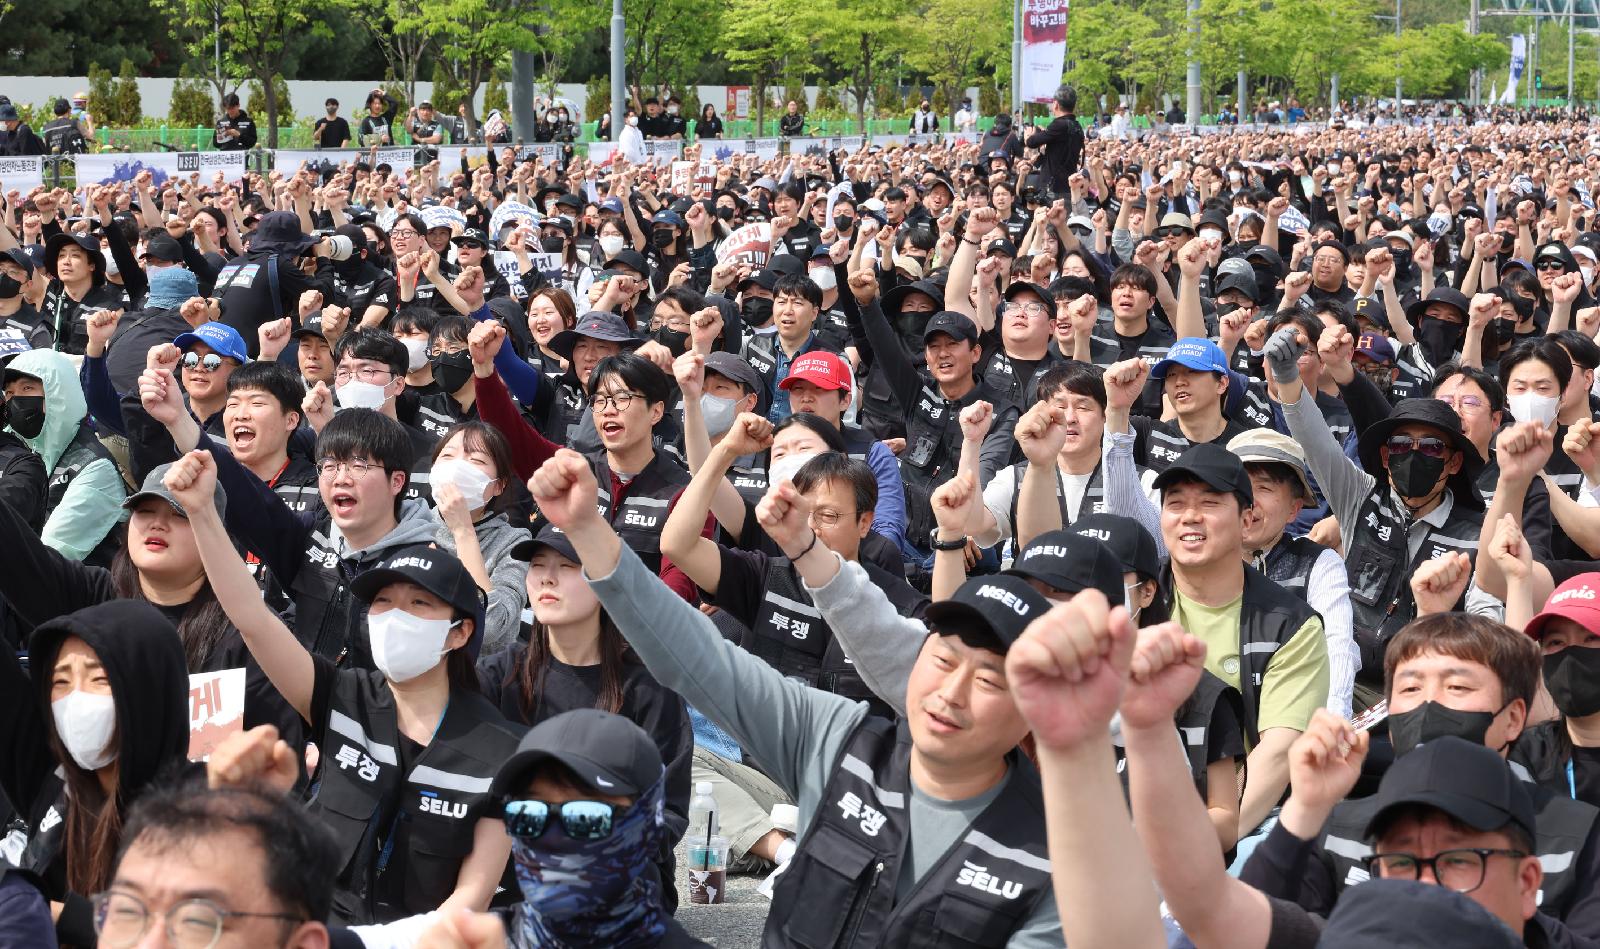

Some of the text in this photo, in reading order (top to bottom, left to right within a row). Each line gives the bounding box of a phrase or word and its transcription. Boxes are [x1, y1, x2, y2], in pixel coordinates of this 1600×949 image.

[1030, 13, 1067, 28] 바꾸고!!!
[179, 156, 198, 169] NSEU
[1356, 299, 1368, 312] P
[1355, 335, 1373, 349] H
[749, 357, 770, 374] 투쟁
[810, 365, 831, 375] AGAIN
[919, 398, 943, 419] 투쟁
[1243, 405, 1270, 426] 투쟁
[421, 419, 449, 438] 투쟁
[1150, 445, 1182, 463] 투쟁
[733, 479, 767, 489] SELU
[624, 513, 657, 527] SELU
[1365, 512, 1392, 542] 투쟁
[305, 544, 339, 569] 투쟁
[1023, 545, 1067, 561] NSEU
[388, 556, 432, 571] NSEU
[976, 584, 1030, 616] NSEU
[769, 611, 810, 640] 투쟁
[335, 743, 381, 782] 투쟁
[419, 796, 469, 819] SELU
[837, 791, 888, 837] 투쟁
[957, 866, 1023, 900] SELU
